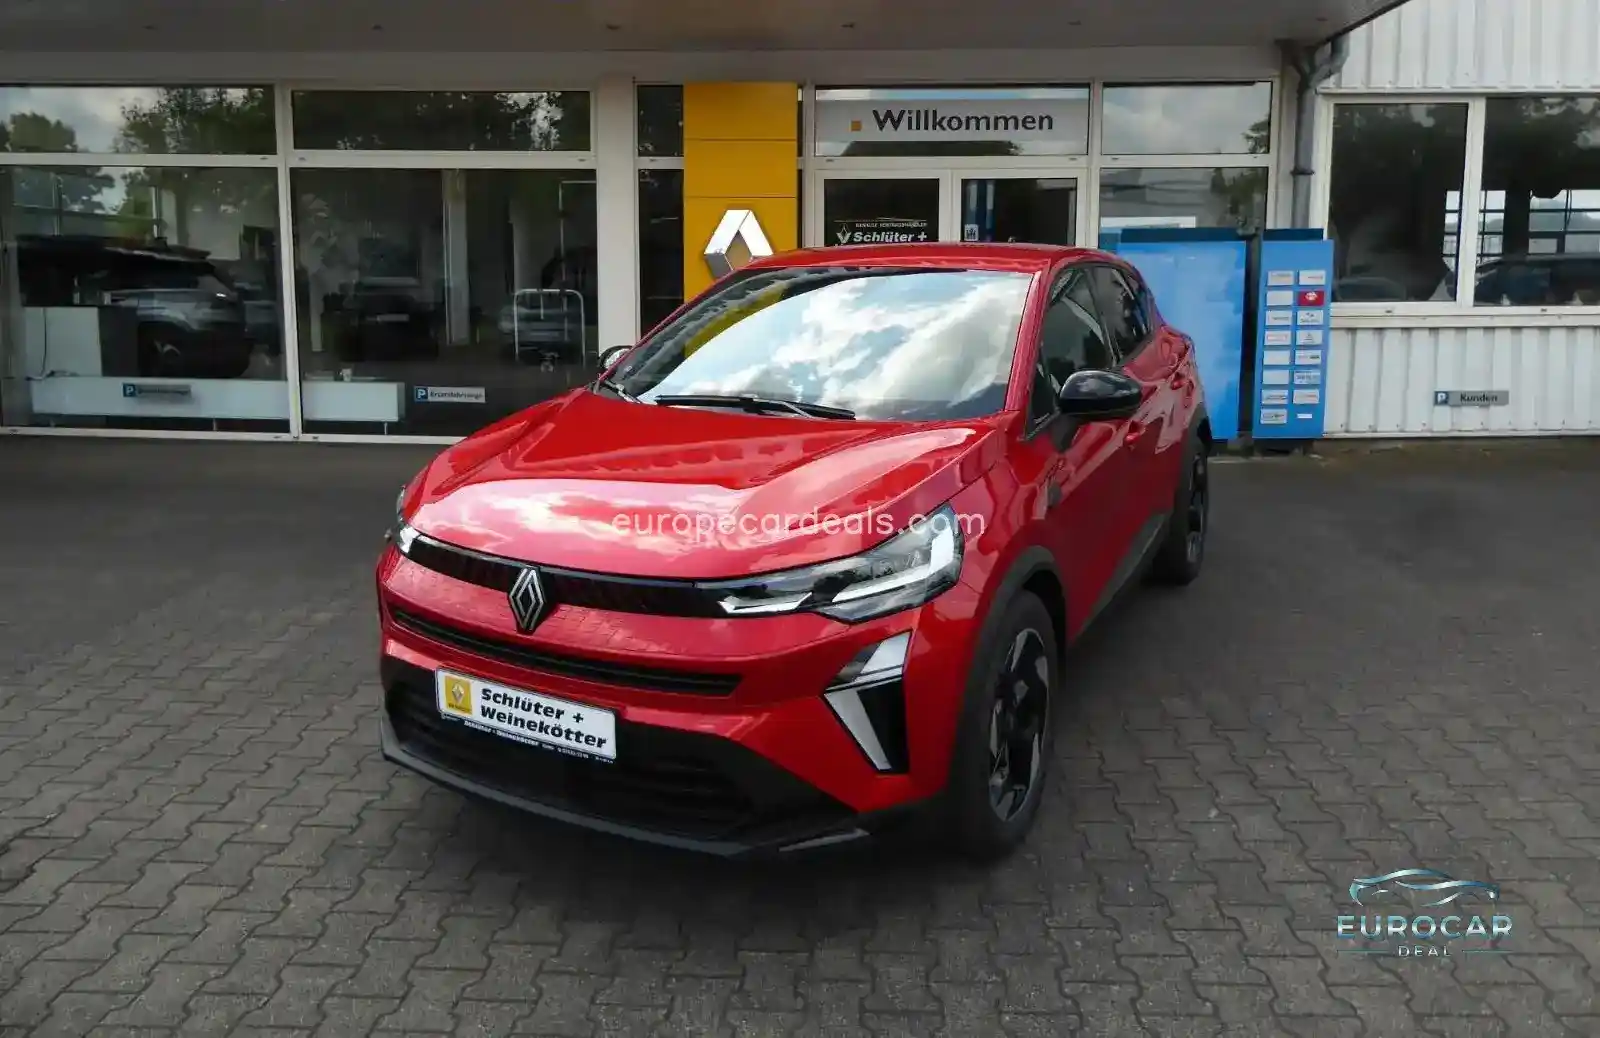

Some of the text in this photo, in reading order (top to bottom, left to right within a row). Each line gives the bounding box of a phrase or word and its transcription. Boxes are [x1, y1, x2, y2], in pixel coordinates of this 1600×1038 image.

[873, 109, 1053, 131] Willkommen
[853, 231, 914, 242] Schlüter
[1460, 393, 1498, 403] Kunden
[481, 688, 565, 720] Schlüter
[480, 705, 607, 748] Weinekötter
